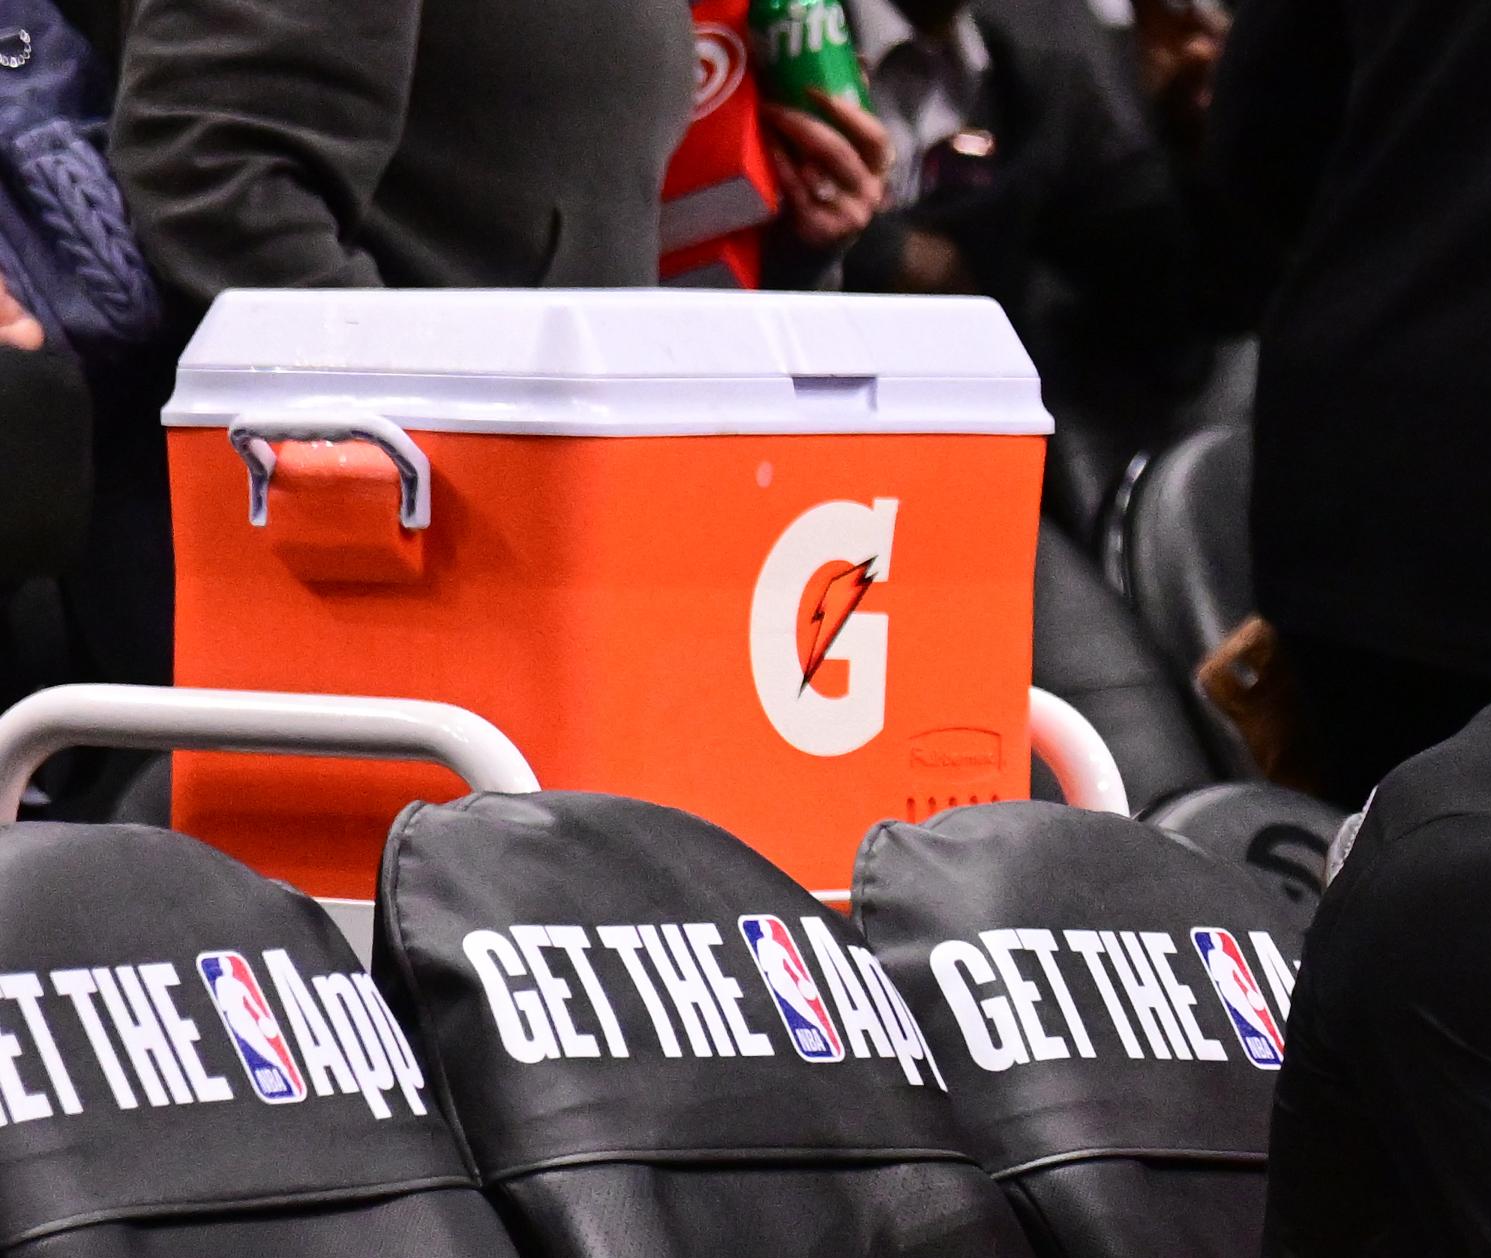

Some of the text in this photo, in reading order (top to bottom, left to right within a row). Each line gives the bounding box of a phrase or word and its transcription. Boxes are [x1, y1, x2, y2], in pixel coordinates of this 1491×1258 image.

[750, 497, 899, 757] G
[0, 972, 84, 1129] ET
[50, 963, 234, 1110] THE
[462, 925, 630, 1064] GET
[596, 922, 776, 1058] THE
[930, 928, 1096, 1072] GET
[1063, 929, 1229, 1062] THE
